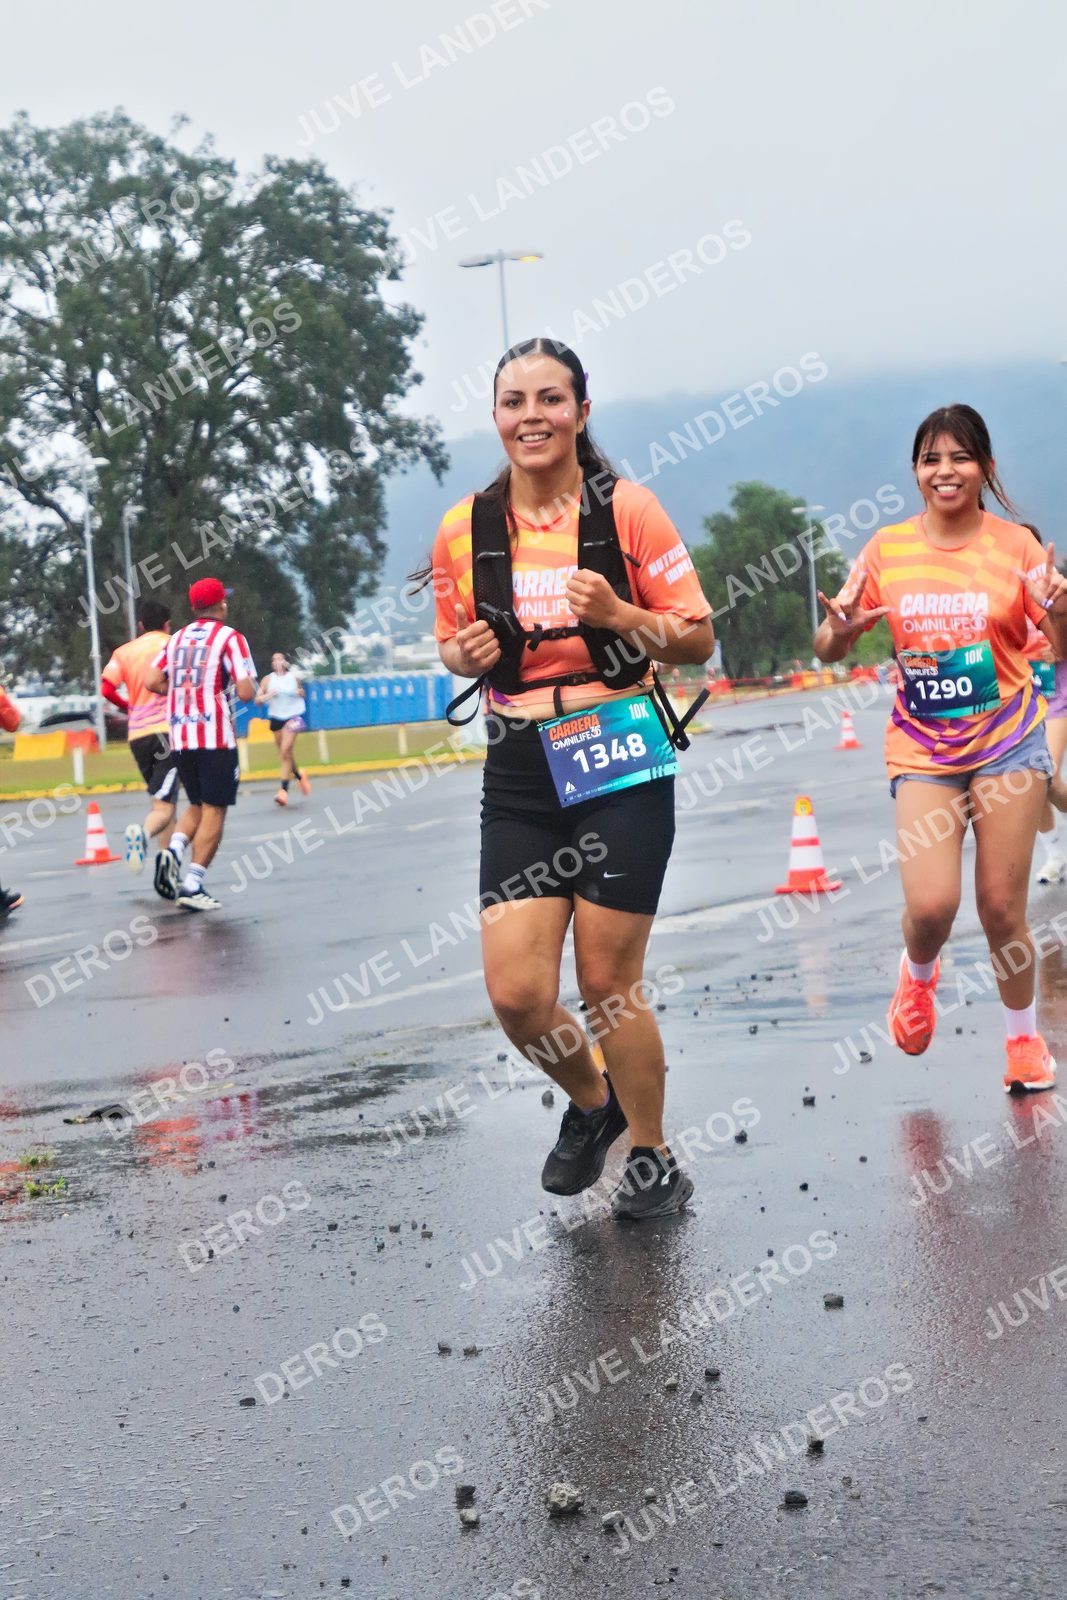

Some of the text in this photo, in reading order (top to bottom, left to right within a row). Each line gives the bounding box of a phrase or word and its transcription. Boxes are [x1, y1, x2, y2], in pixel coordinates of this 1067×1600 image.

[900, 592, 989, 617] CARRERA
[964, 648, 983, 665] 10K
[915, 676, 973, 699] 1290
[629, 702, 649, 720] 10K
[549, 714, 600, 741] CARRERA
[572, 733, 647, 773] 1348
